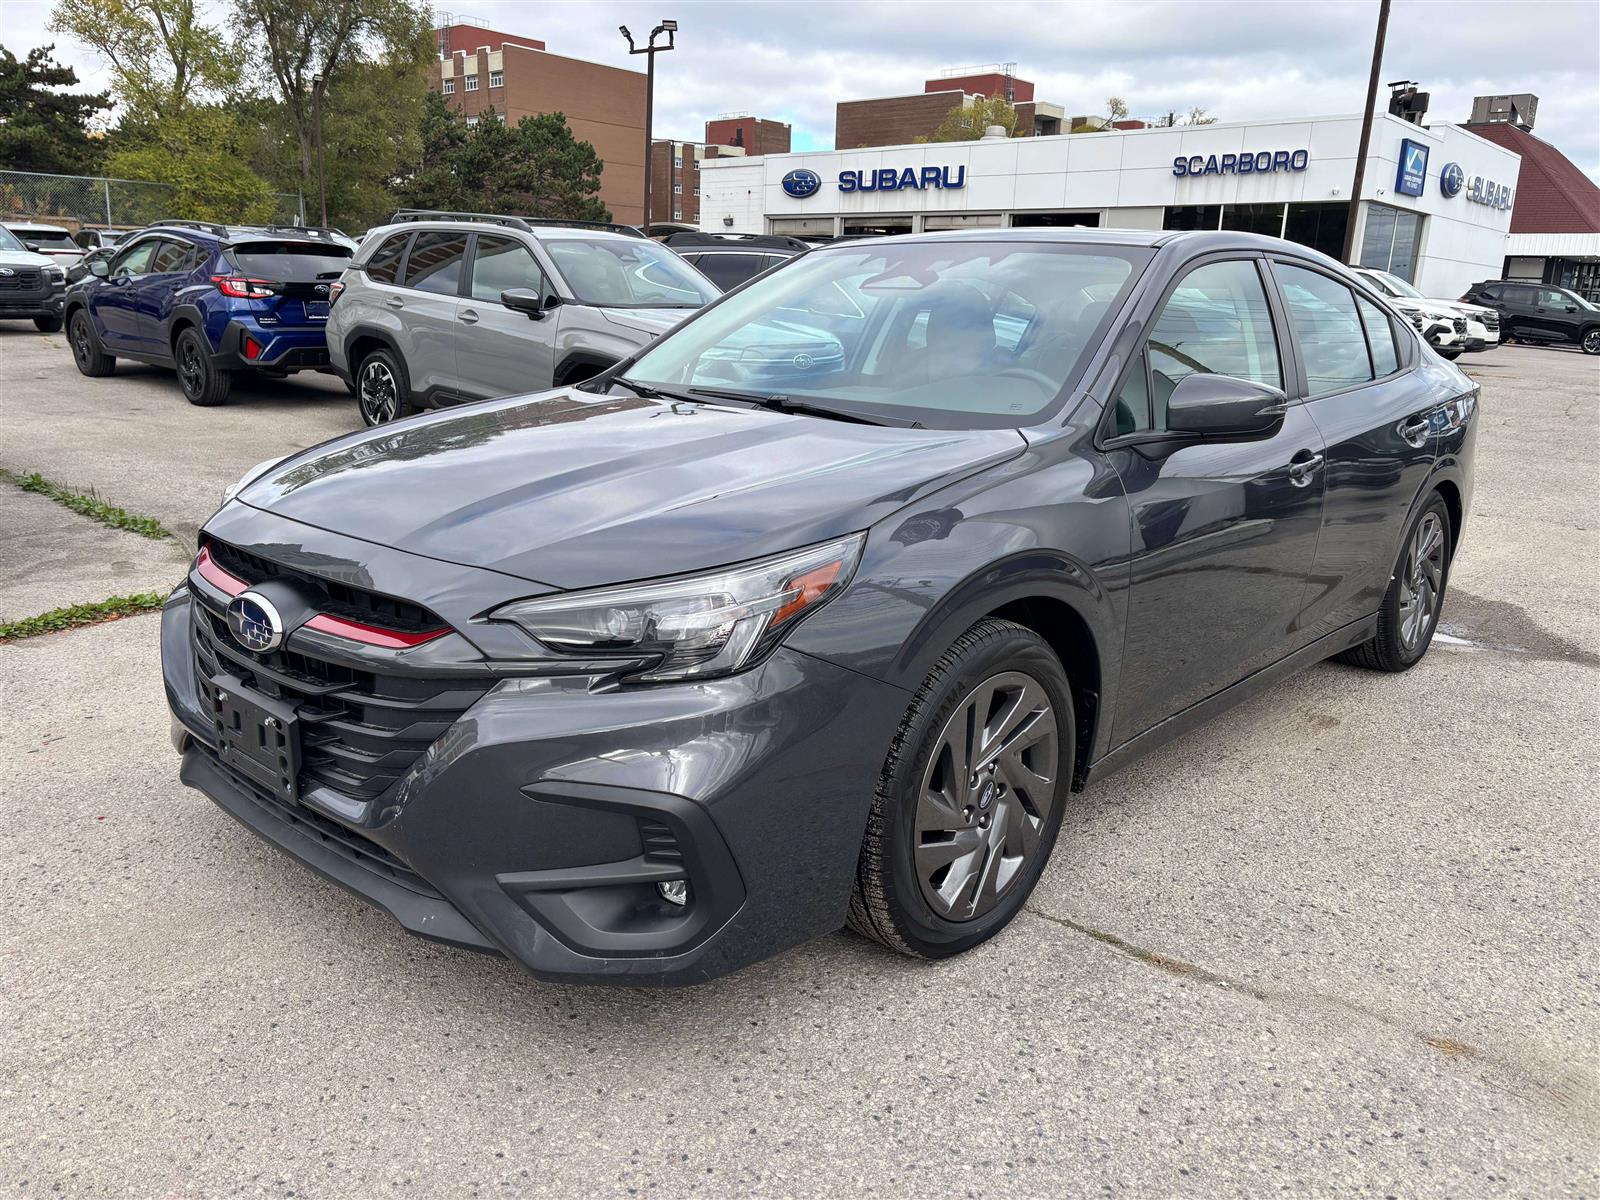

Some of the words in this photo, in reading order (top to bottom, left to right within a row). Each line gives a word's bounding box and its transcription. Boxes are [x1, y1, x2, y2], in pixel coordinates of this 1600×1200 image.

[838, 165, 966, 192] SUBARU
[1173, 149, 1309, 177] SCARBORO
[1468, 176, 1515, 210] SUBARU
[911, 680, 966, 773] YOKOHAMA
